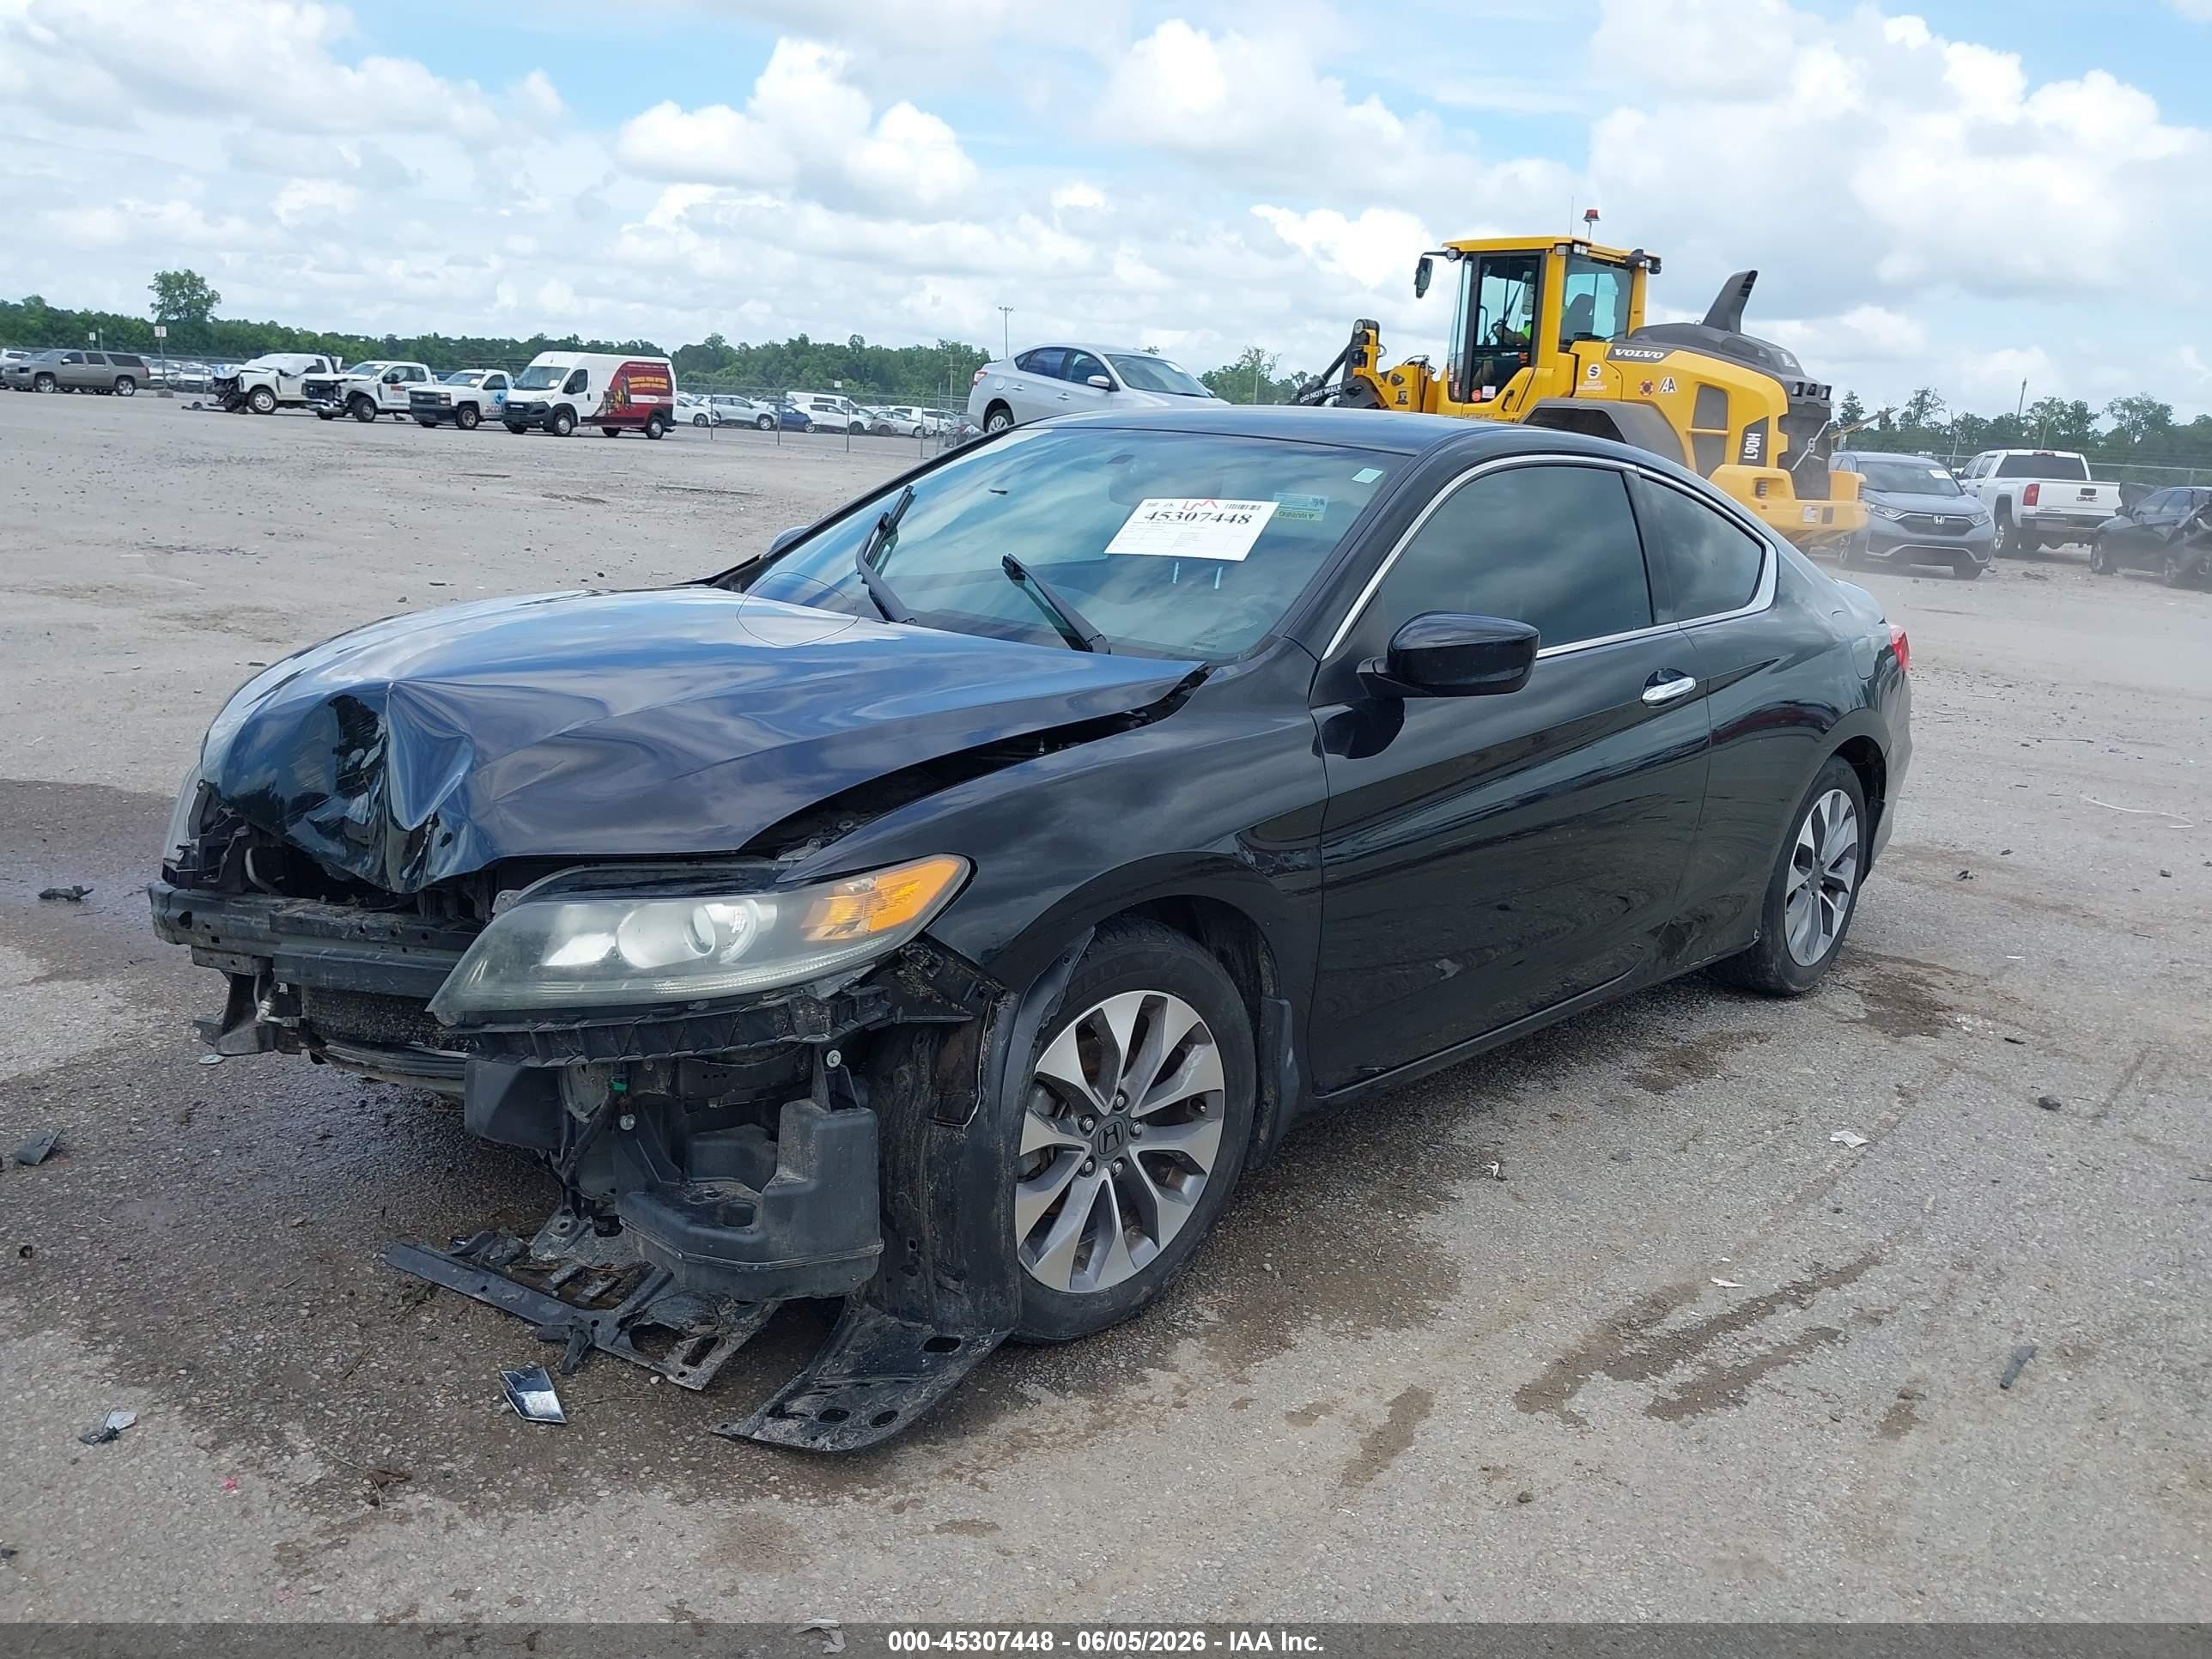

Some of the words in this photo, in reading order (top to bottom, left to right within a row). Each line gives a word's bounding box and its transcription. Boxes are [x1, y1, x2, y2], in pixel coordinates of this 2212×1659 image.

[1614, 349, 1664, 359] VOLVO
[1299, 394, 1310, 404] DO
[1310, 389, 1323, 399] NOT
[1743, 433, 1761, 459] L90H
[1144, 511, 1253, 525] 45307448
